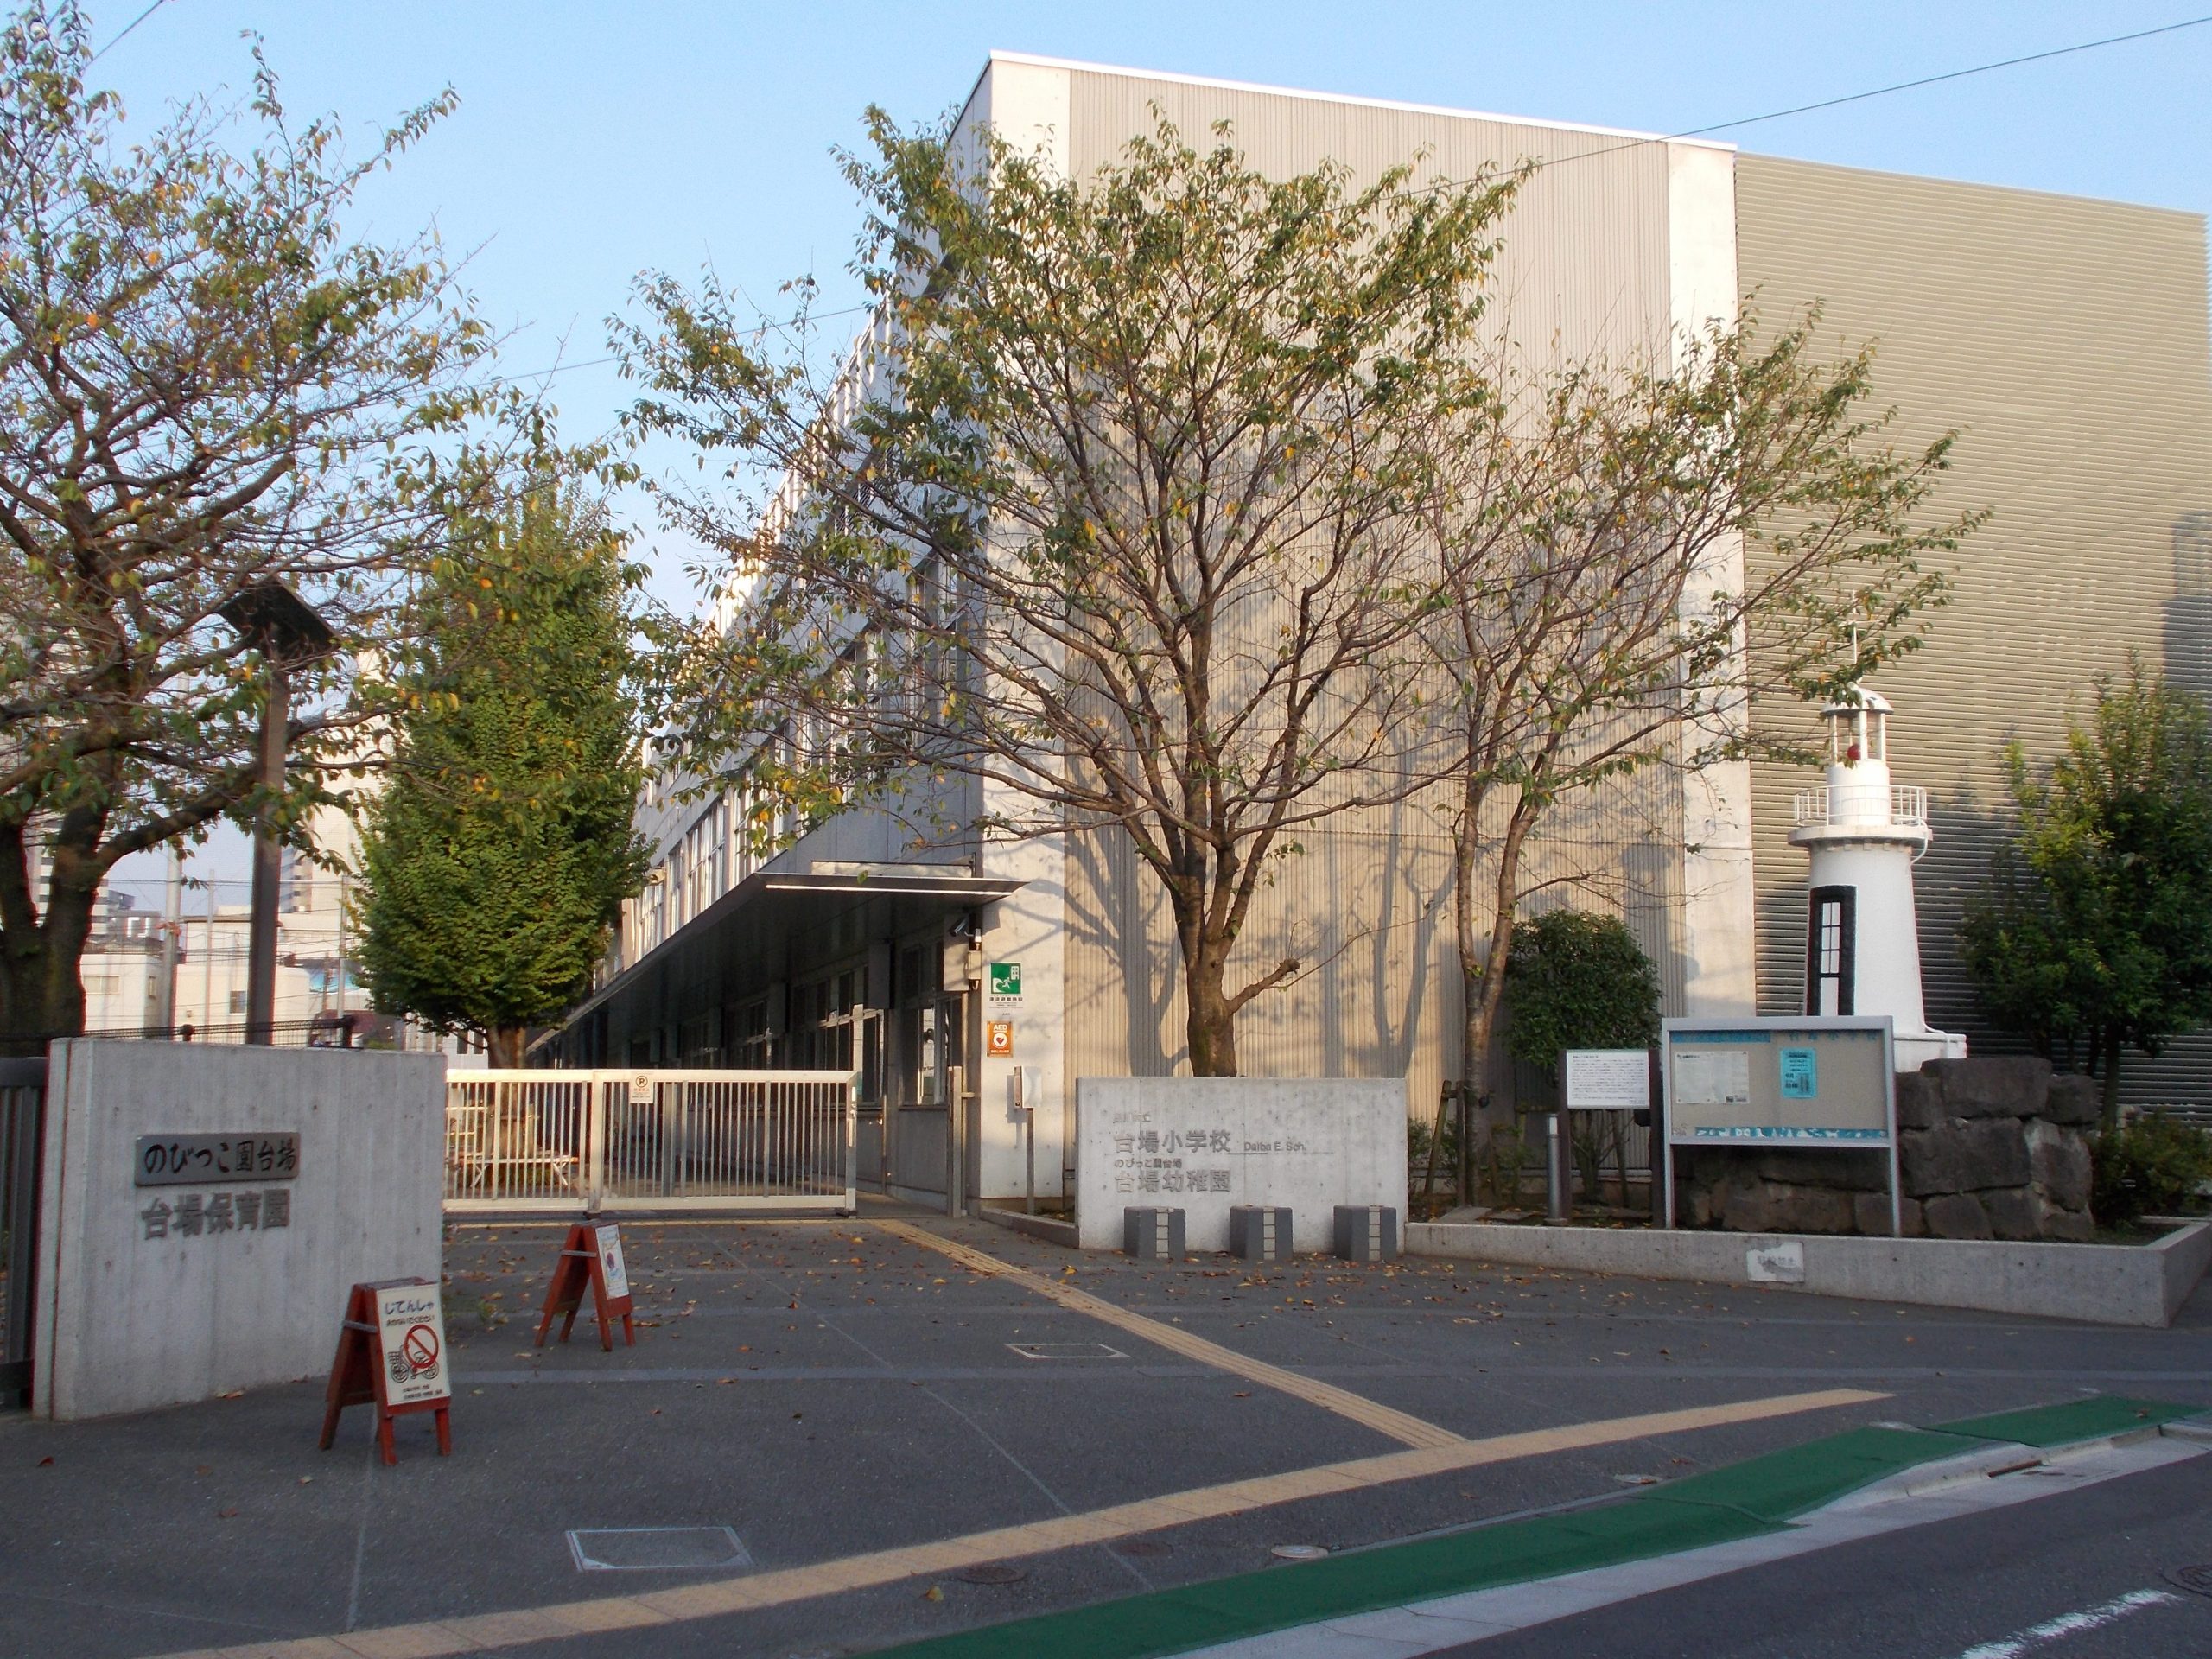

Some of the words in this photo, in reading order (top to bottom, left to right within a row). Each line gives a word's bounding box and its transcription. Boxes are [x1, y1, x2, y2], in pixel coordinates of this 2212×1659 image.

[1114, 1129, 1231, 1154] 台場小学校
[1243, 1141, 1272, 1152] Daiba
[1114, 1169, 1231, 1193] 台場幼稚園
[141, 1189, 290, 1240] 台場保育園
